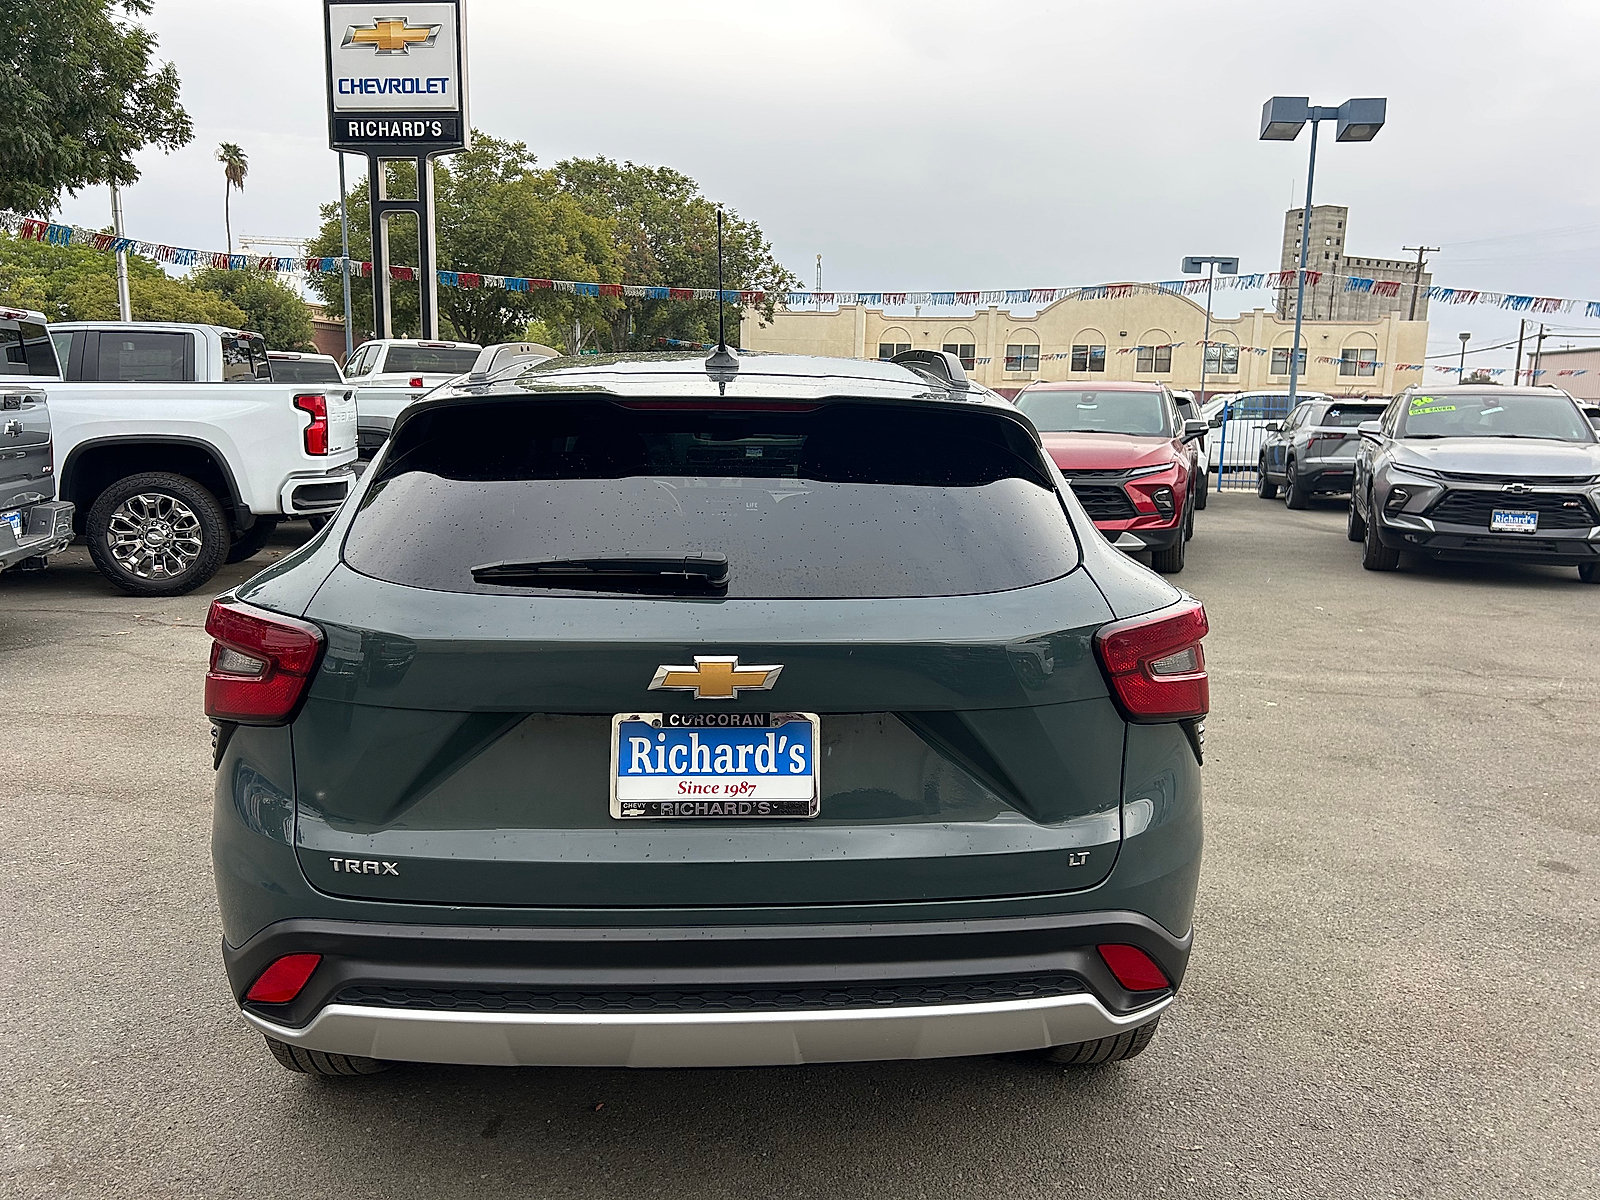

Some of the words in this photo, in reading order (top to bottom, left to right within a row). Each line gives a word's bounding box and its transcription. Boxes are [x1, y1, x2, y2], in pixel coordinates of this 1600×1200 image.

[338, 77, 449, 95] CHEVROLET
[348, 121, 442, 137] RICHARD'S
[1495, 514, 1535, 524] Richard's
[669, 714, 764, 726] CORCORAN
[627, 732, 806, 774] Richard's
[677, 781, 720, 795] Since
[724, 781, 756, 797] 1987
[660, 803, 771, 816] RICHARD'S
[329, 857, 399, 876] TRAX
[1069, 851, 1091, 867] LT
